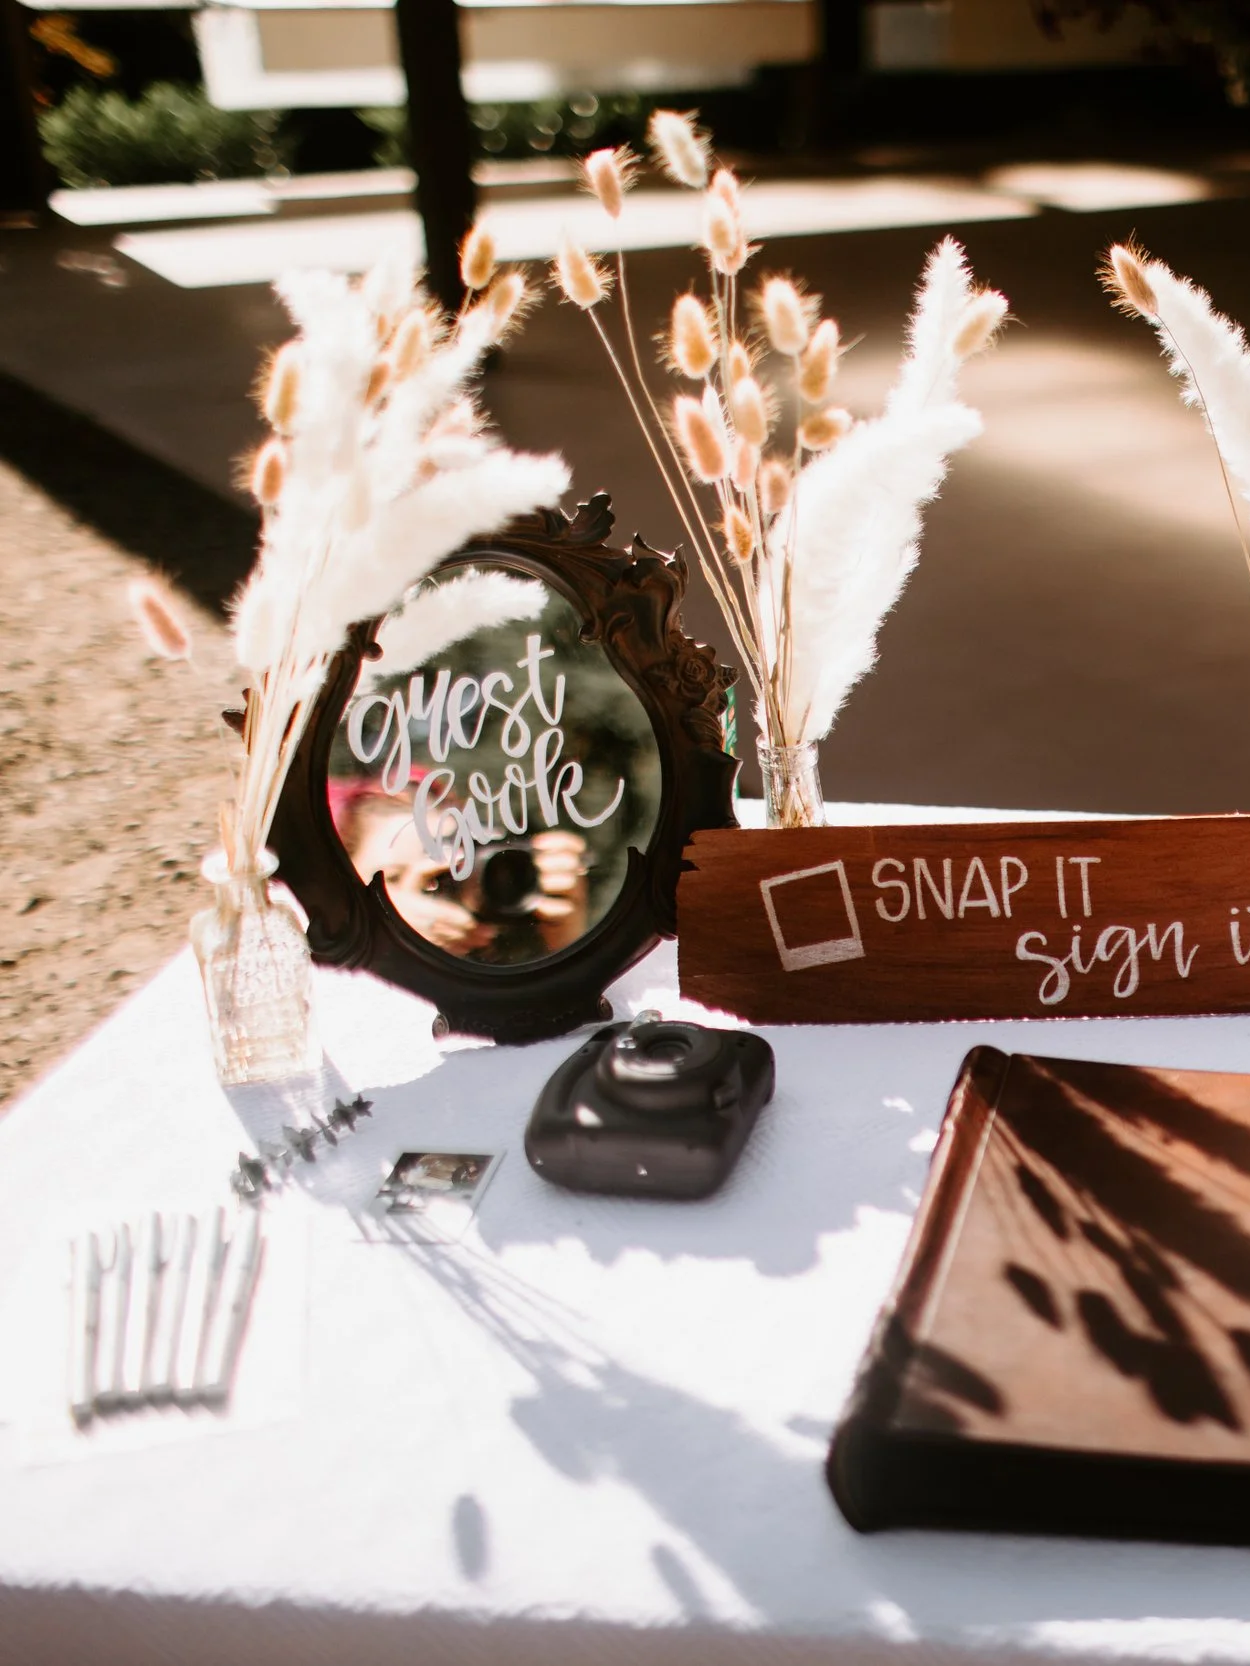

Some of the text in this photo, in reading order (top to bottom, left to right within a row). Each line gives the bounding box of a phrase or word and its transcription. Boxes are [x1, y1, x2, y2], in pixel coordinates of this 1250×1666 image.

[348, 634, 565, 795] guest
[413, 728, 625, 881] book
[871, 856, 1102, 922] SNAP IT
[1015, 922, 1200, 1005] sign
